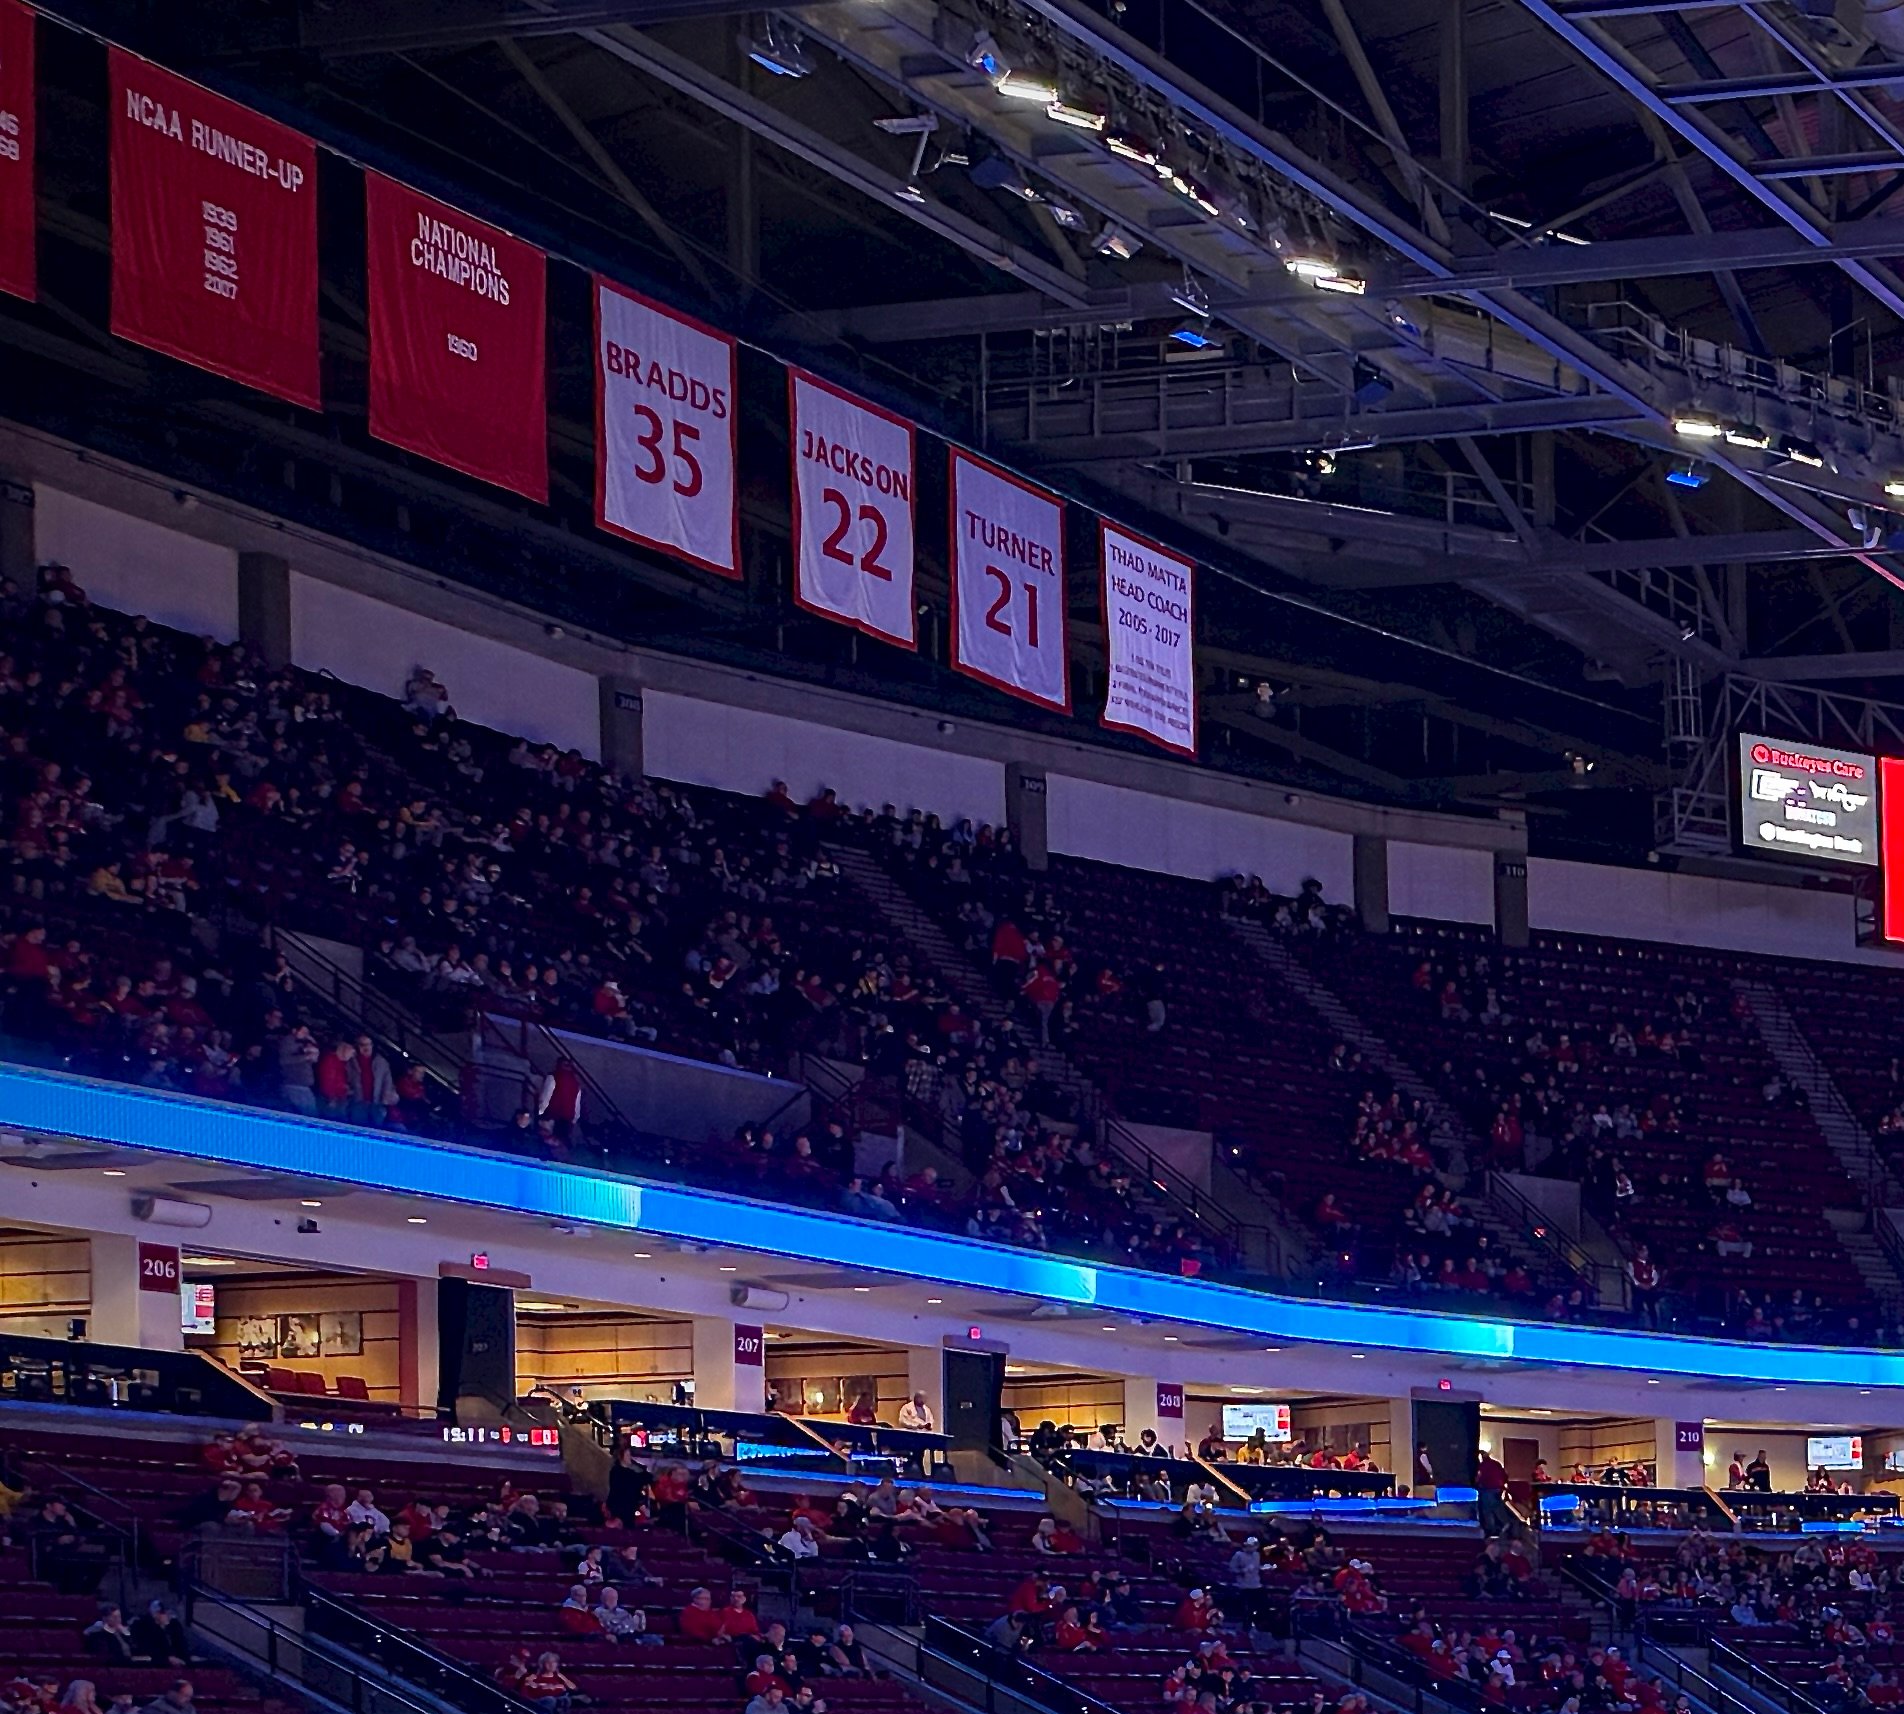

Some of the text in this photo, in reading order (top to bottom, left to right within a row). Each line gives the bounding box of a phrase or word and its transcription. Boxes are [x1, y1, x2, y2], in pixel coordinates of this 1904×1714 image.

[126, 88, 304, 193] NCAA RUNNER-UP
[203, 249, 239, 280] 1962
[417, 211, 503, 276] NATIONAL
[203, 273, 238, 300] 2007
[409, 239, 511, 307] CHAMPIONS
[446, 332, 479, 362] 1960
[606, 340, 728, 420] BRADDS
[632, 402, 703, 499] 35
[801, 429, 910, 502] JACKSON
[821, 487, 893, 582] 22
[964, 509, 1055, 577] TURNER
[1109, 543, 1188, 595] THAD MATTA
[985, 565, 1039, 648] 21
[1111, 574, 1188, 624] HEAD COACH
[1833, 761, 1864, 779] Care
[143, 1258, 176, 1279] 206
[737, 1337, 759, 1353] 207
[1679, 1431, 1700, 1443] 210
